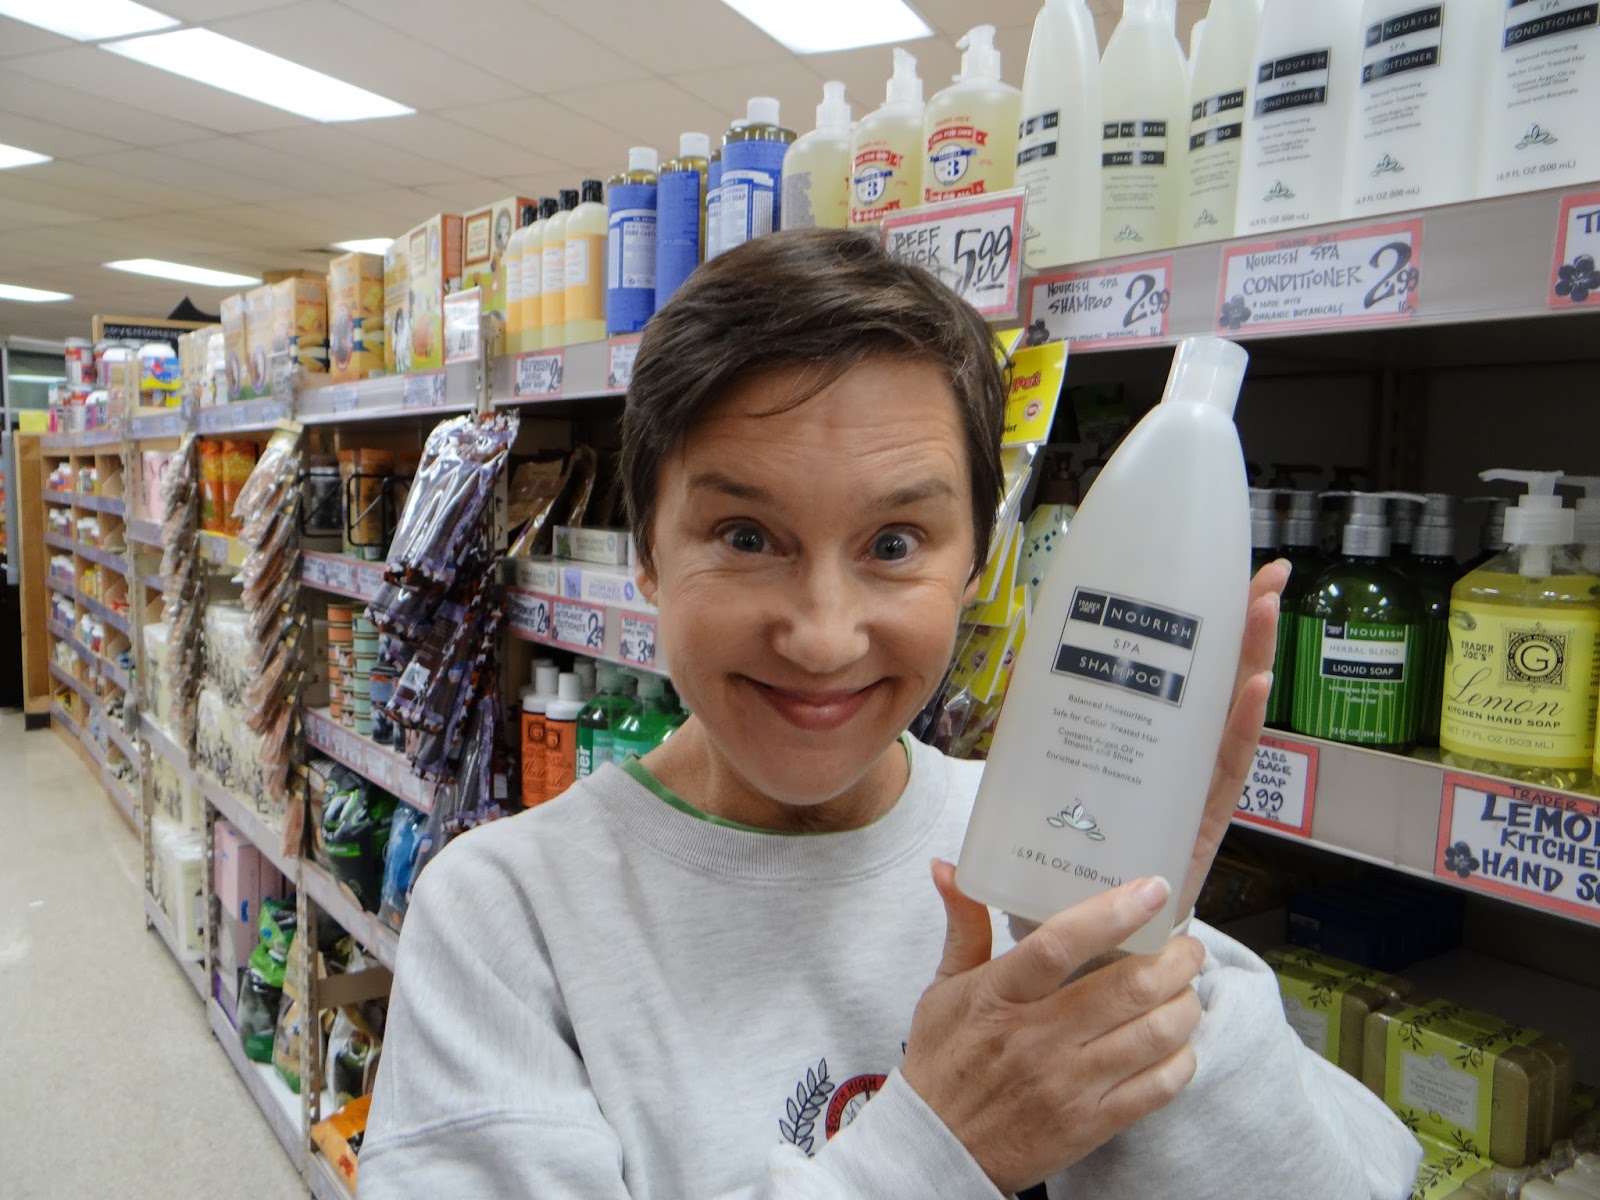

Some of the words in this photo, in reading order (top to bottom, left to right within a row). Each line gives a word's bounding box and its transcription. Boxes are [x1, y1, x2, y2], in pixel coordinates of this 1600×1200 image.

[1384, 12, 1438, 34] NOURISH
[1507, 10, 1591, 42] CONDITIONER
[1389, 42, 1407, 52] SPA
[1276, 56, 1325, 72] NOURISH
[1281, 80, 1297, 89] SPA
[1261, 89, 1320, 109] ONDITIONER
[947, 160, 959, 176] 3
[867, 181, 878, 196] 3
[893, 226, 941, 249] BEEF
[1246, 249, 1299, 271] NOURISH
[1310, 244, 1340, 262] SPA
[1047, 279, 1090, 298] NOURISH
[1099, 277, 1118, 289] SPA
[1243, 265, 1364, 296] CONDITIONER
[1048, 294, 1113, 315] SHAMPOO
[1252, 310, 1290, 321] ORGANIC
[1293, 303, 1343, 317] BOTANICALS
[1110, 607, 1192, 639] NOURISH
[1349, 627, 1404, 638] NOURISH
[1113, 638, 1140, 655] SPA
[1329, 644, 1365, 655] HERBAL
[1368, 647, 1399, 656] BLEND
[1460, 640, 1494, 653] TRADER
[1463, 651, 1487, 661] JOE'S
[1332, 663, 1367, 675] LIQUID
[1369, 666, 1394, 676] SOAP
[1520, 645, 1550, 672] G
[1079, 656, 1161, 688] SHAMPOO
[1449, 664, 1565, 717] Lemon
[1068, 693, 1103, 709] Balanced
[1104, 703, 1153, 726] Moisturizing
[1447, 705, 1483, 720] KITCHEN
[1487, 714, 1523, 726] HAND
[1527, 718, 1561, 729] SOAP
[1052, 707, 1068, 718] Safe
[1069, 711, 1082, 721] for
[1083, 715, 1107, 728] Color
[1110, 721, 1141, 739] Treated
[1141, 732, 1159, 744] Hair
[1058, 726, 1093, 743] Contains
[1094, 737, 1119, 751] Argan
[1120, 743, 1134, 755] Oil
[1135, 749, 1144, 758] to
[1063, 737, 1094, 752] Smooth
[1095, 746, 1111, 757] and
[1112, 751, 1134, 764] Shine
[1472, 731, 1483, 740] FL
[1487, 734, 1504, 744] OZ
[1505, 737, 1533, 748] (503
[1046, 750, 1081, 767] Enriched
[1082, 760, 1100, 772] with
[1102, 765, 1142, 786] Botanicals
[1252, 771, 1287, 789] SOAP
[1237, 785, 1284, 813] 3.99
[1510, 785, 1579, 811] TRADER
[1500, 827, 1600, 871] KITCHE
[1035, 852, 1048, 866] FL
[1051, 857, 1072, 873] OZ
[1074, 864, 1098, 881] (500
[1100, 875, 1122, 888] mL)
[1481, 848, 1564, 893] HAND
[827, 1092, 847, 1133] SOUTH
[846, 1077, 878, 1094] HIGH
